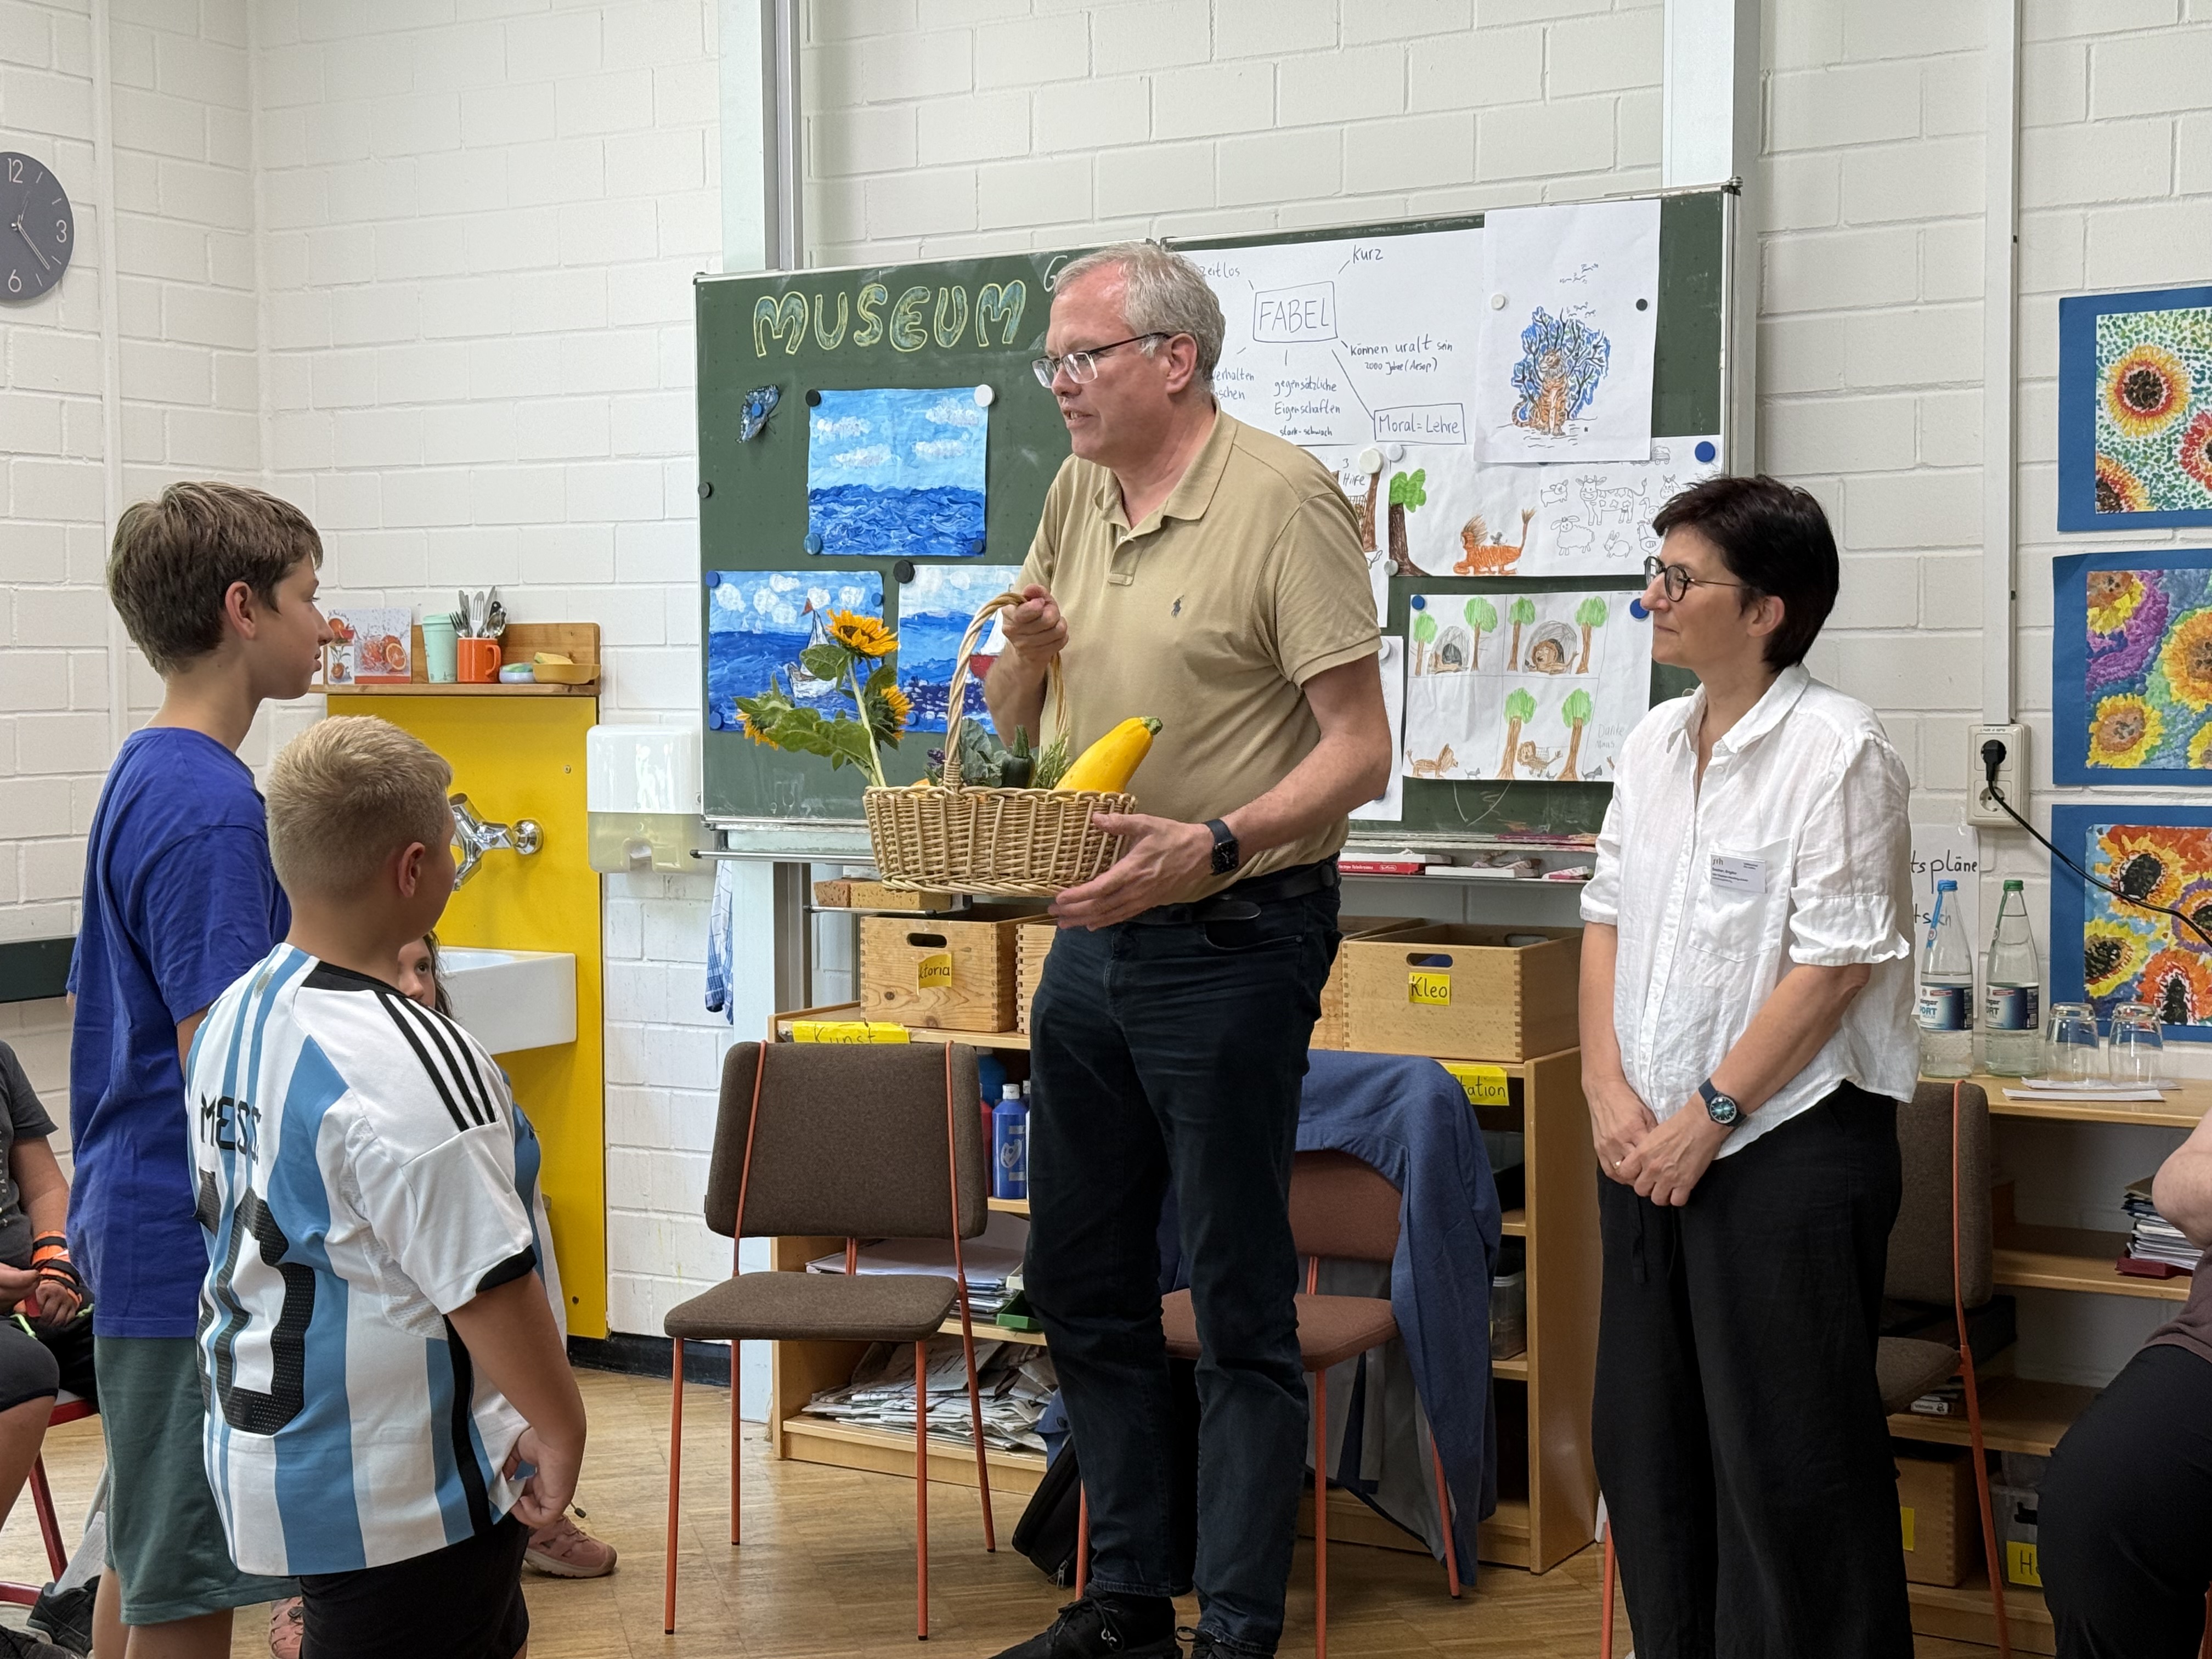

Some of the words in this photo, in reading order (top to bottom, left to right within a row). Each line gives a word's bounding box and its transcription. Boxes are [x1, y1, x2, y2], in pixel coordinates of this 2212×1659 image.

[7, 157, 24, 183] 12
[56, 219, 67, 243] 3
[8, 269, 22, 292] 6
[754, 280, 1026, 357] MUSEUM
[1260, 298, 1329, 333] FABEL
[1395, 334, 1432, 353] uralt
[1436, 339, 1453, 352] sein
[1273, 375, 1338, 397] gegensätzliche
[1274, 399, 1340, 421] Eigenschaften
[1410, 975, 1448, 998] Kleo
